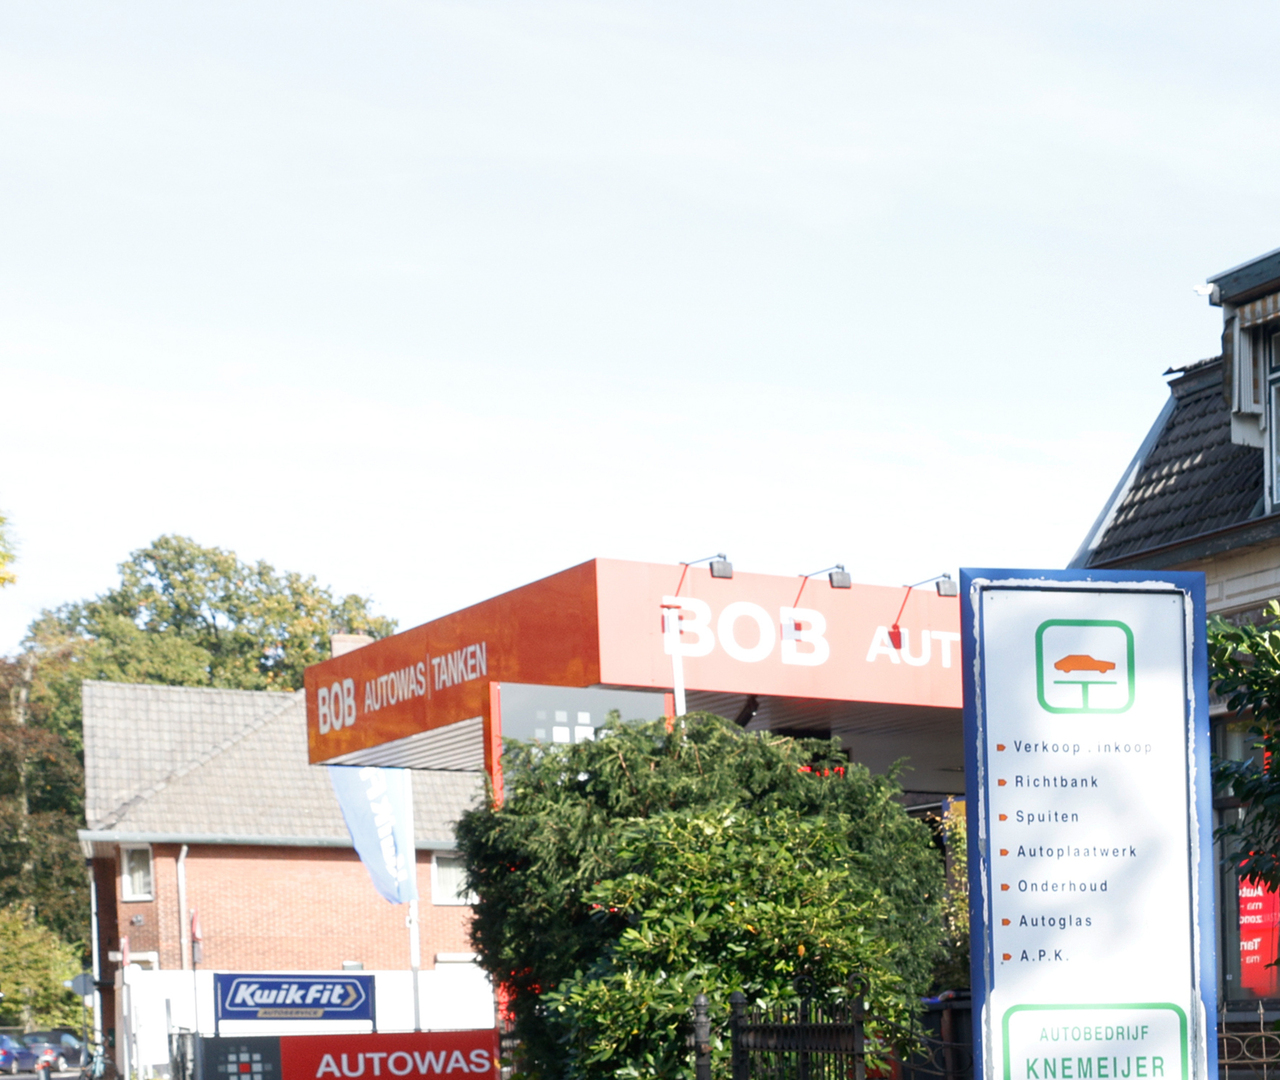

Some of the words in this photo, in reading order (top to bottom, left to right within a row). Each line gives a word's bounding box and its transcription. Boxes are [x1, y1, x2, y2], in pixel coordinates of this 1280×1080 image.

[661, 596, 830, 666] BOB
[317, 678, 357, 735] BOB
[364, 661, 427, 713] AUTOWAS
[431, 641, 488, 691] TANKEN
[1013, 740, 1081, 755] Verkoop
[1097, 742, 1153, 755] inkoop
[1015, 775, 1099, 788] Richtbank
[1016, 810, 1079, 825] Spuiten
[1017, 845, 1137, 860] Autoplaatwerk
[1018, 880, 1108, 893] Onderhoud
[1019, 915, 1092, 930] Autoglas
[1020, 949, 1070, 963] A.P.K.
[1039, 1025, 1149, 1042] AUTOBEDRIJF
[316, 1049, 491, 1079] AUTOWAS
[1026, 1056, 1165, 1080] KNEMEIJER
